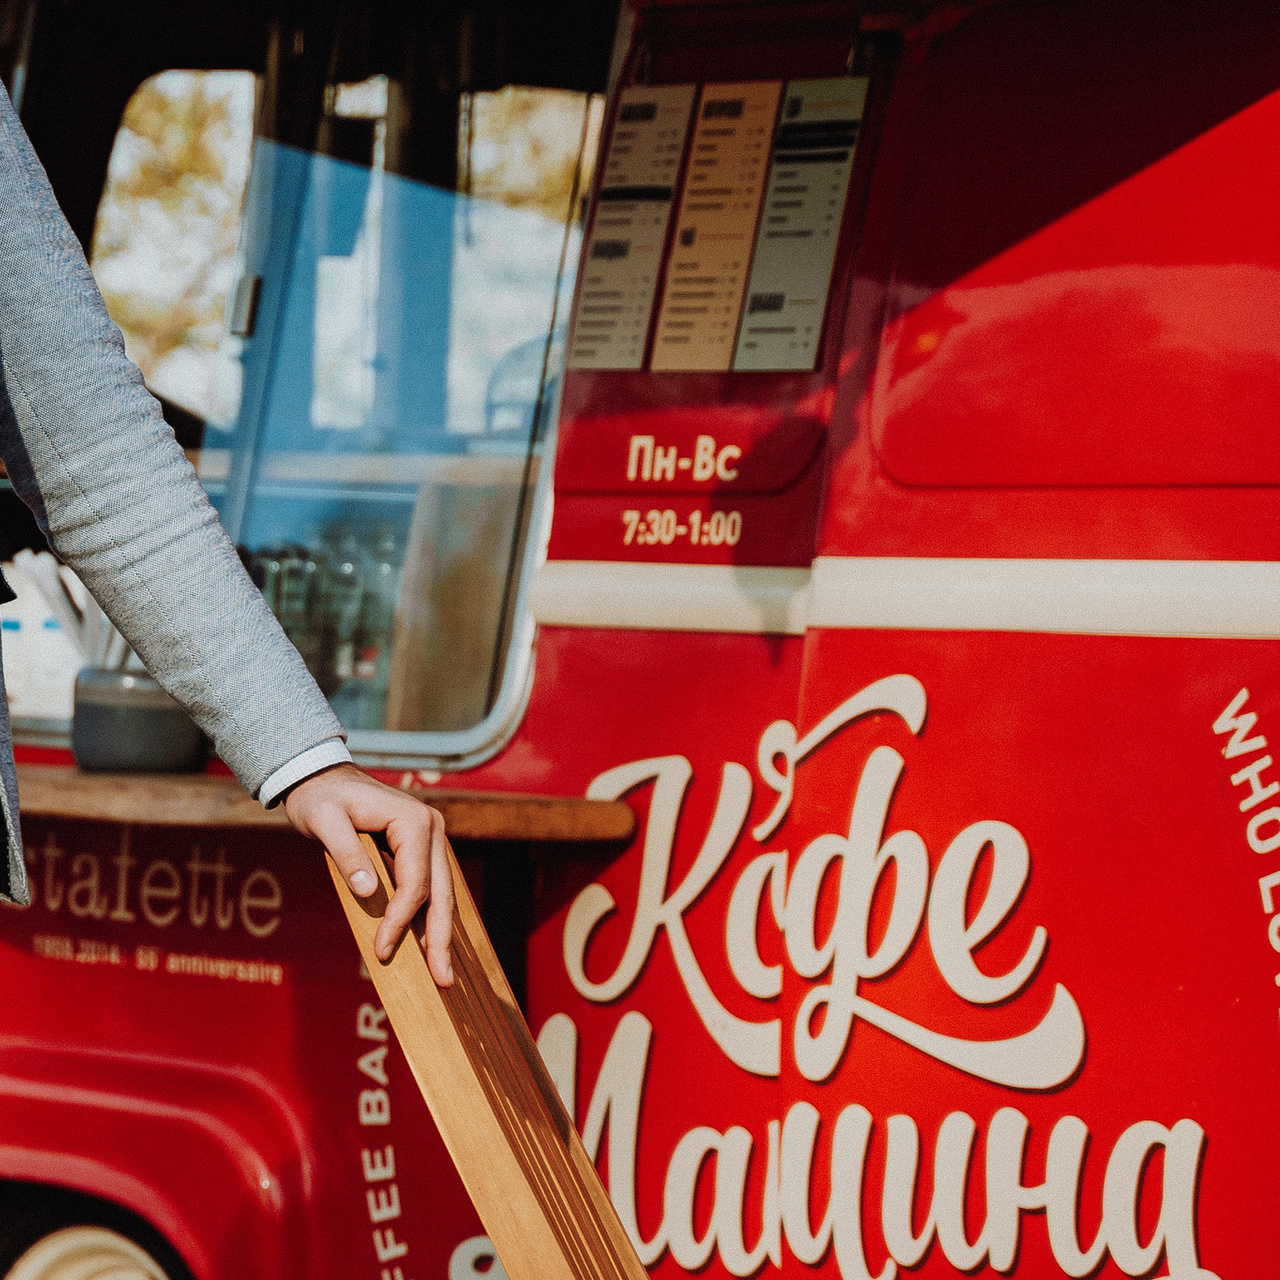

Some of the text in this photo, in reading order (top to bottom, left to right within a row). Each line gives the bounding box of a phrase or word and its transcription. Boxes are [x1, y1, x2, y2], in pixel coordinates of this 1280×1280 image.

[626, 434, 742, 482] Пн-Вс
[622, 509, 742, 546] 7:30-1:00
[563, 673, 1085, 1092] Кофе
[356, 1001, 391, 1126] BAR
